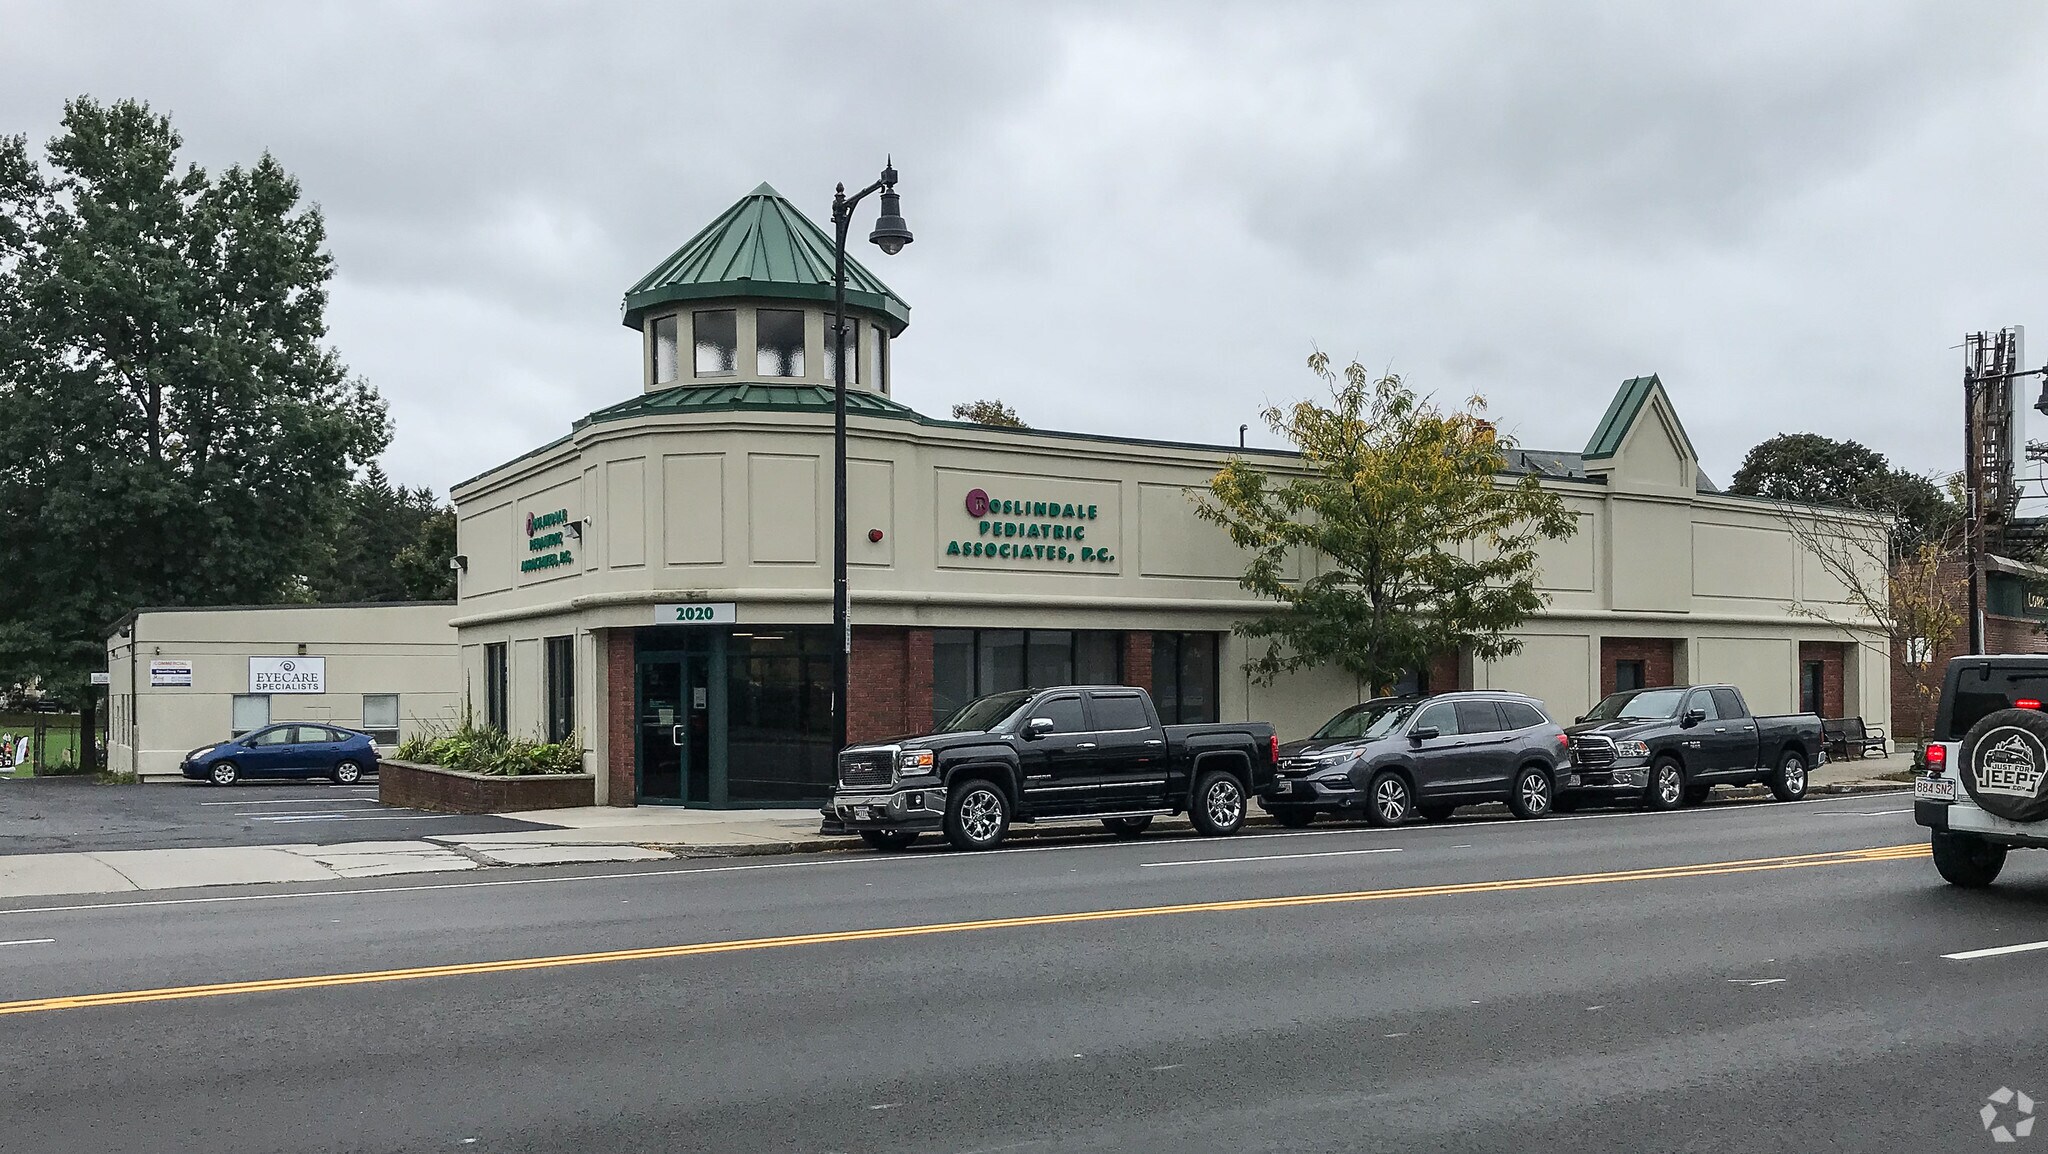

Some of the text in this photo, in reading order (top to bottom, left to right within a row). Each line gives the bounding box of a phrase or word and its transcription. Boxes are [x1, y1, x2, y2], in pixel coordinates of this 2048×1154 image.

[972, 495, 1098, 520] ROSLINDALE
[979, 521, 1085, 540] PEDIATRIC
[947, 540, 1115, 563] ASSOCIATES, P.C.
[676, 606, 714, 621] 2020
[256, 672, 319, 683] EYECARE
[256, 683, 319, 691] SPECIALISTS
[1992, 763, 2030, 773] JUST FOR
[1917, 781, 1953, 796] 884 SN2
[1979, 769, 2039, 793] JEEPS
